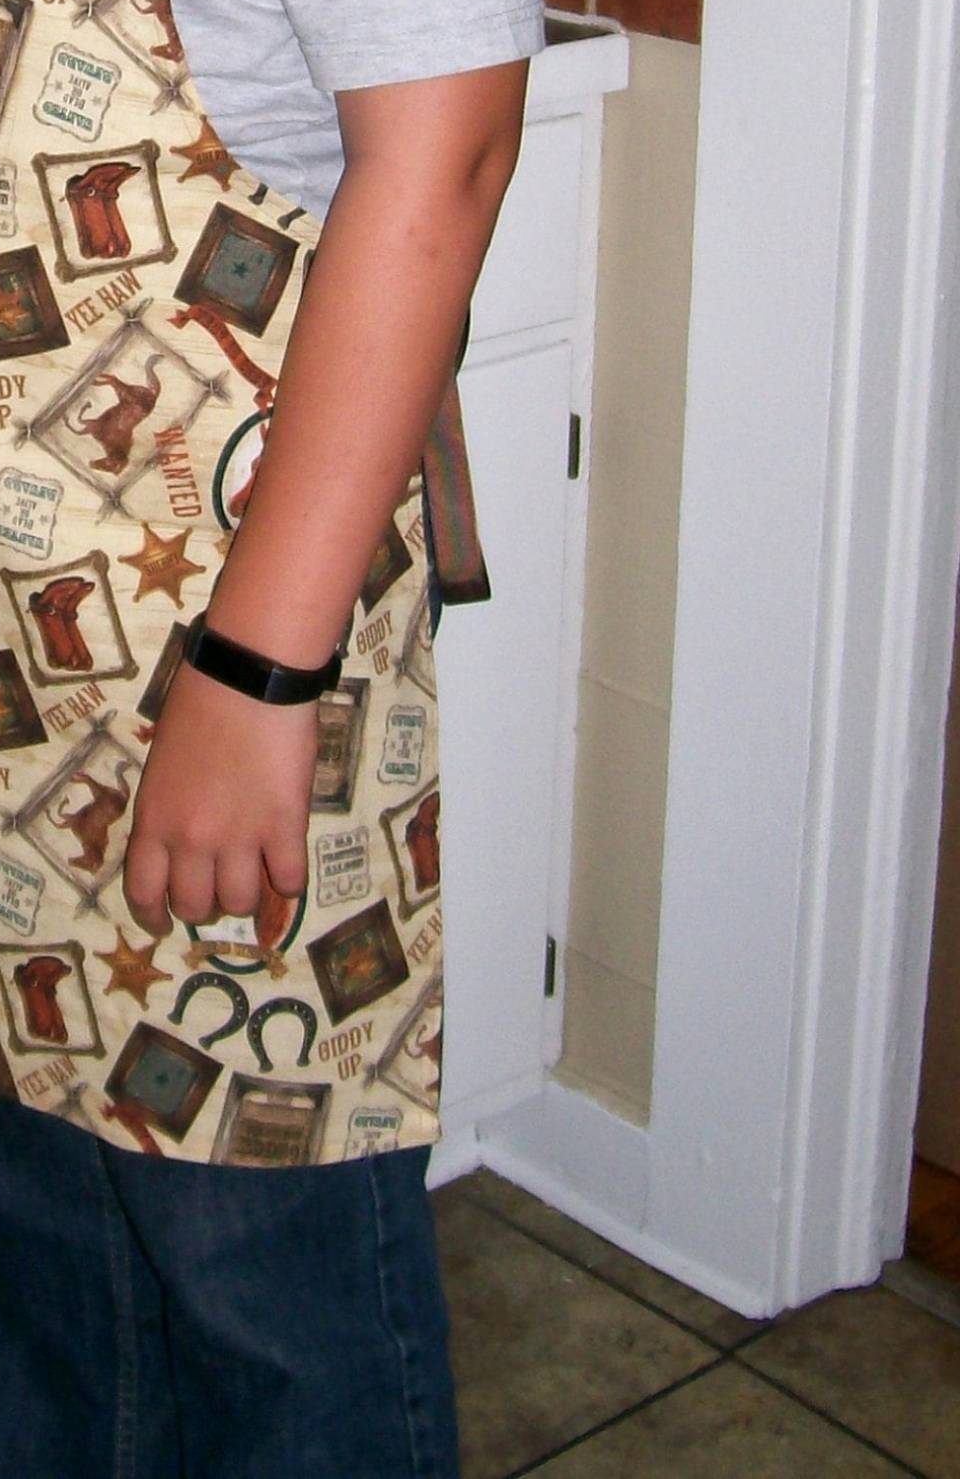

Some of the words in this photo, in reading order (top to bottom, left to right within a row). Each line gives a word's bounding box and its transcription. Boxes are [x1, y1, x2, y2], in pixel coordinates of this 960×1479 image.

[64, 296, 106, 333] YEE
[95, 267, 143, 312] HAW
[153, 424, 203, 518] WANTED
[355, 609, 393, 656] GIDDY
[372, 646, 390, 676] UP
[41, 703, 75, 733] YEE
[64, 674, 107, 719] HAW
[405, 927, 433, 965] YEE
[318, 1020, 374, 1063] GIDDY
[337, 1053, 362, 1082] UP
